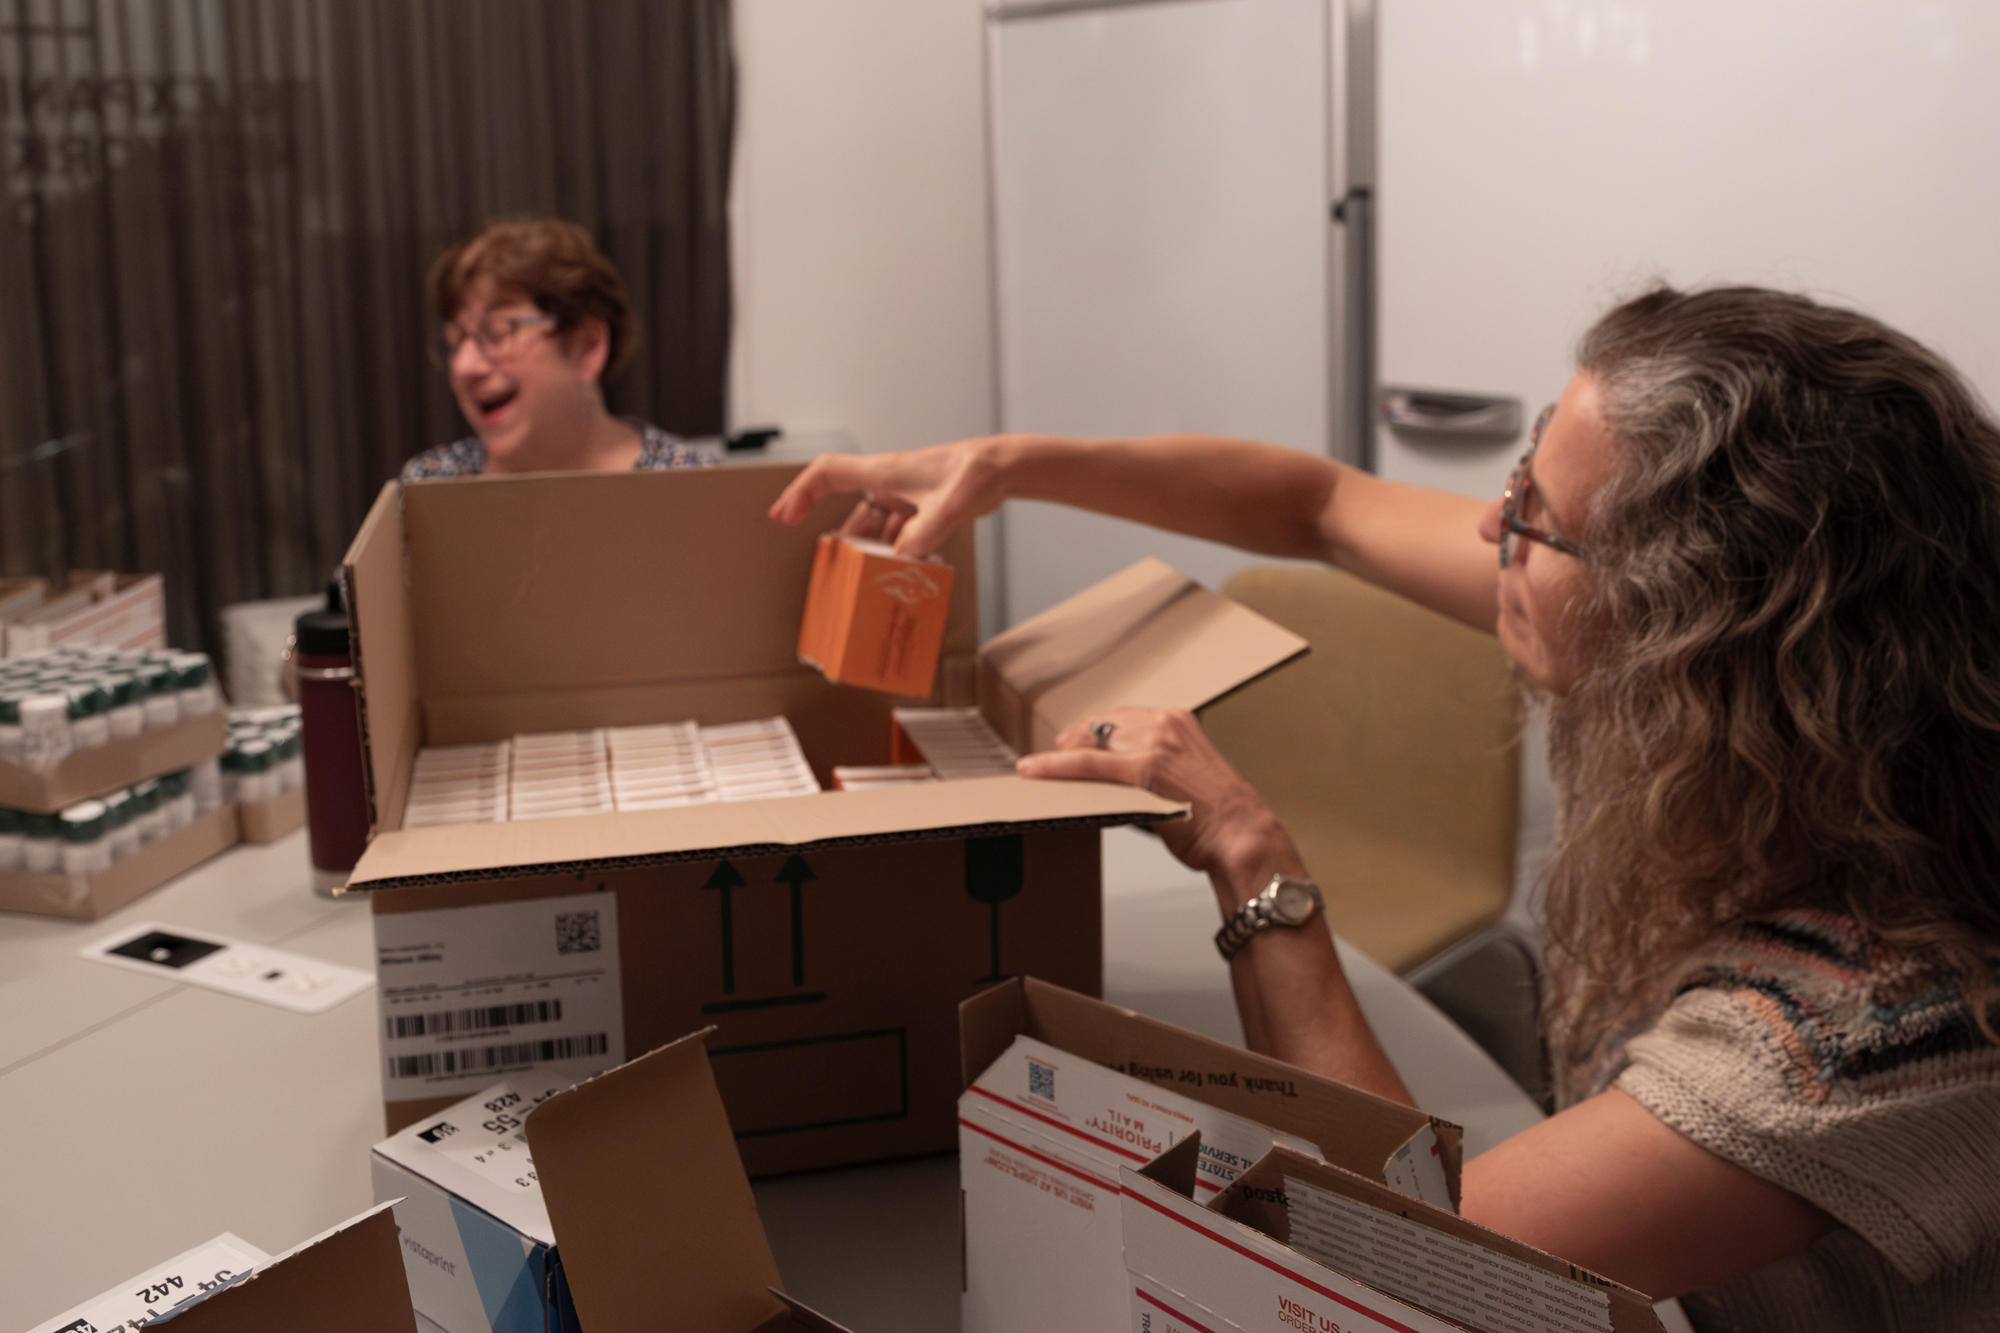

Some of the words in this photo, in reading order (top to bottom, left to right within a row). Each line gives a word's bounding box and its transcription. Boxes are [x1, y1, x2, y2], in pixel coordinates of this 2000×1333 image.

[1178, 1069, 1203, 1087] for
[1208, 1071, 1238, 1088] you
[1242, 1075, 1298, 1097] Thank
[1107, 1108, 1145, 1133] MAIL
[1199, 1143, 1239, 1167] SERVIC
[1197, 1159, 1235, 1181] STATE
[135, 1275, 184, 1304] 442
[1278, 1295, 1316, 1324] VISIT
[1319, 1316, 1341, 1333] US
[1278, 1310, 1316, 1333] ORDER
